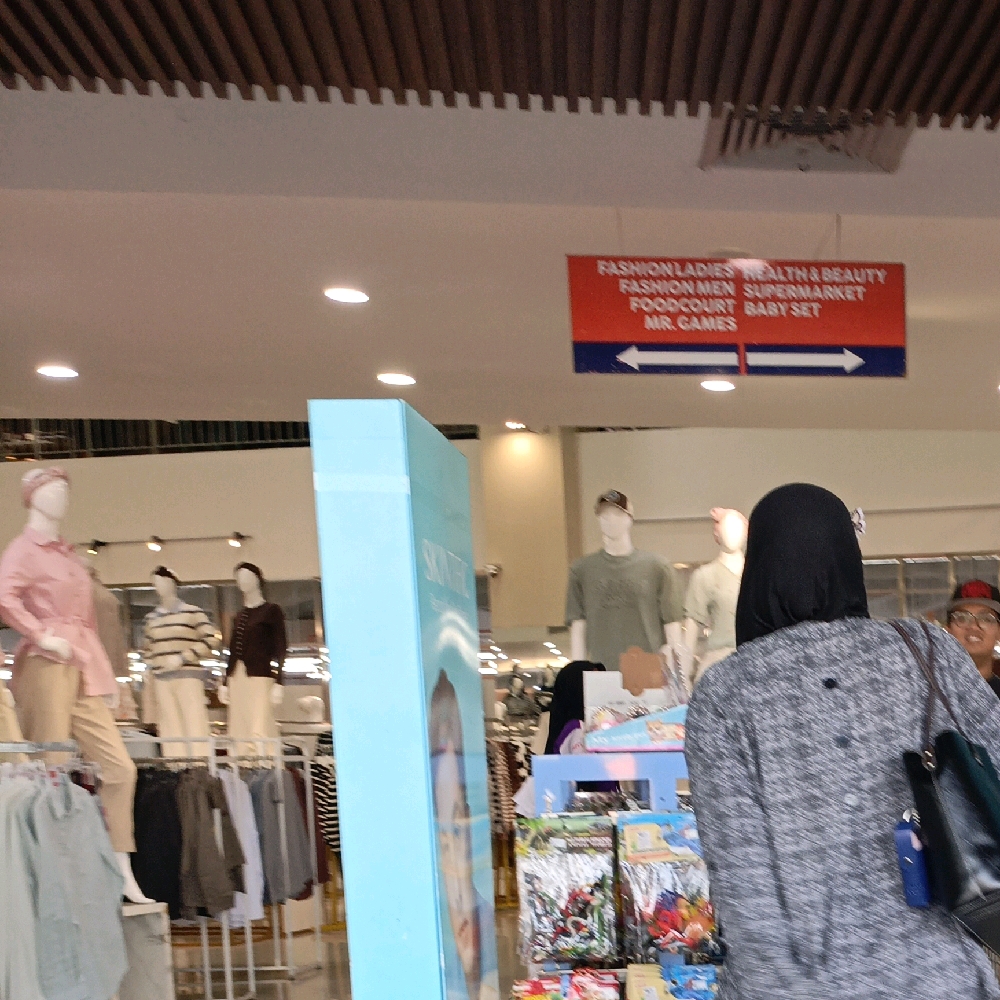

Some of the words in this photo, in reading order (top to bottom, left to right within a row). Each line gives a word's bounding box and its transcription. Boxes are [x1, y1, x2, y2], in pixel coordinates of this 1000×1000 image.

[597, 260, 674, 277] FASHION
[673, 262, 736, 279] LADIES
[742, 265, 809, 282] HEALTH
[809, 266, 821, 282] &
[821, 266, 887, 284] BEAUTY
[619, 279, 695, 295] FASHION
[696, 280, 736, 296] MEN
[743, 283, 866, 301] SUPERMARKET
[629, 297, 737, 314] FOODCOURT
[743, 301, 789, 317] BABY
[790, 302, 822, 318] SET
[644, 315, 677, 331] MR.
[677, 315, 738, 332] GAMES
